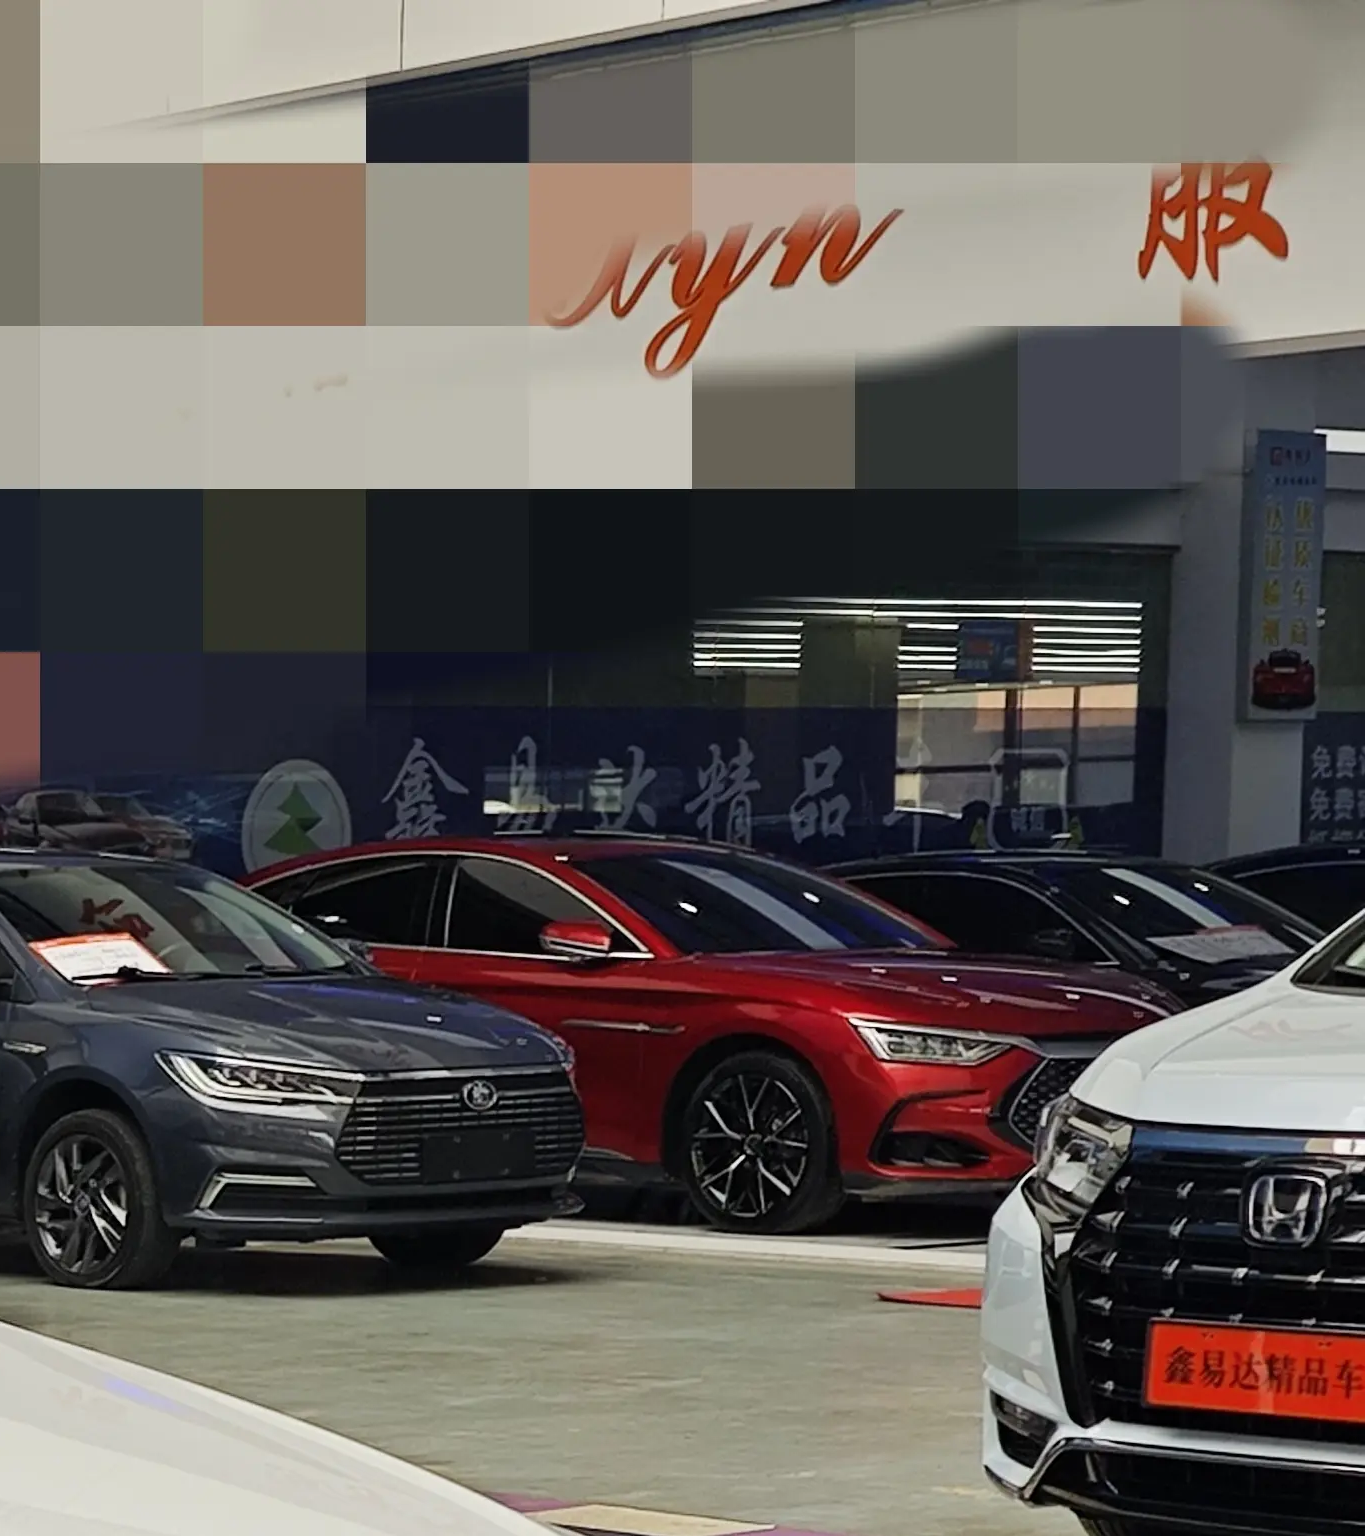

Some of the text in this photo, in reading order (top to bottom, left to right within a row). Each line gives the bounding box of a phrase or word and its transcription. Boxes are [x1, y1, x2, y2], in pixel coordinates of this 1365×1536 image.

[1162, 1344, 1365, 1400] 鑫易达精品车
